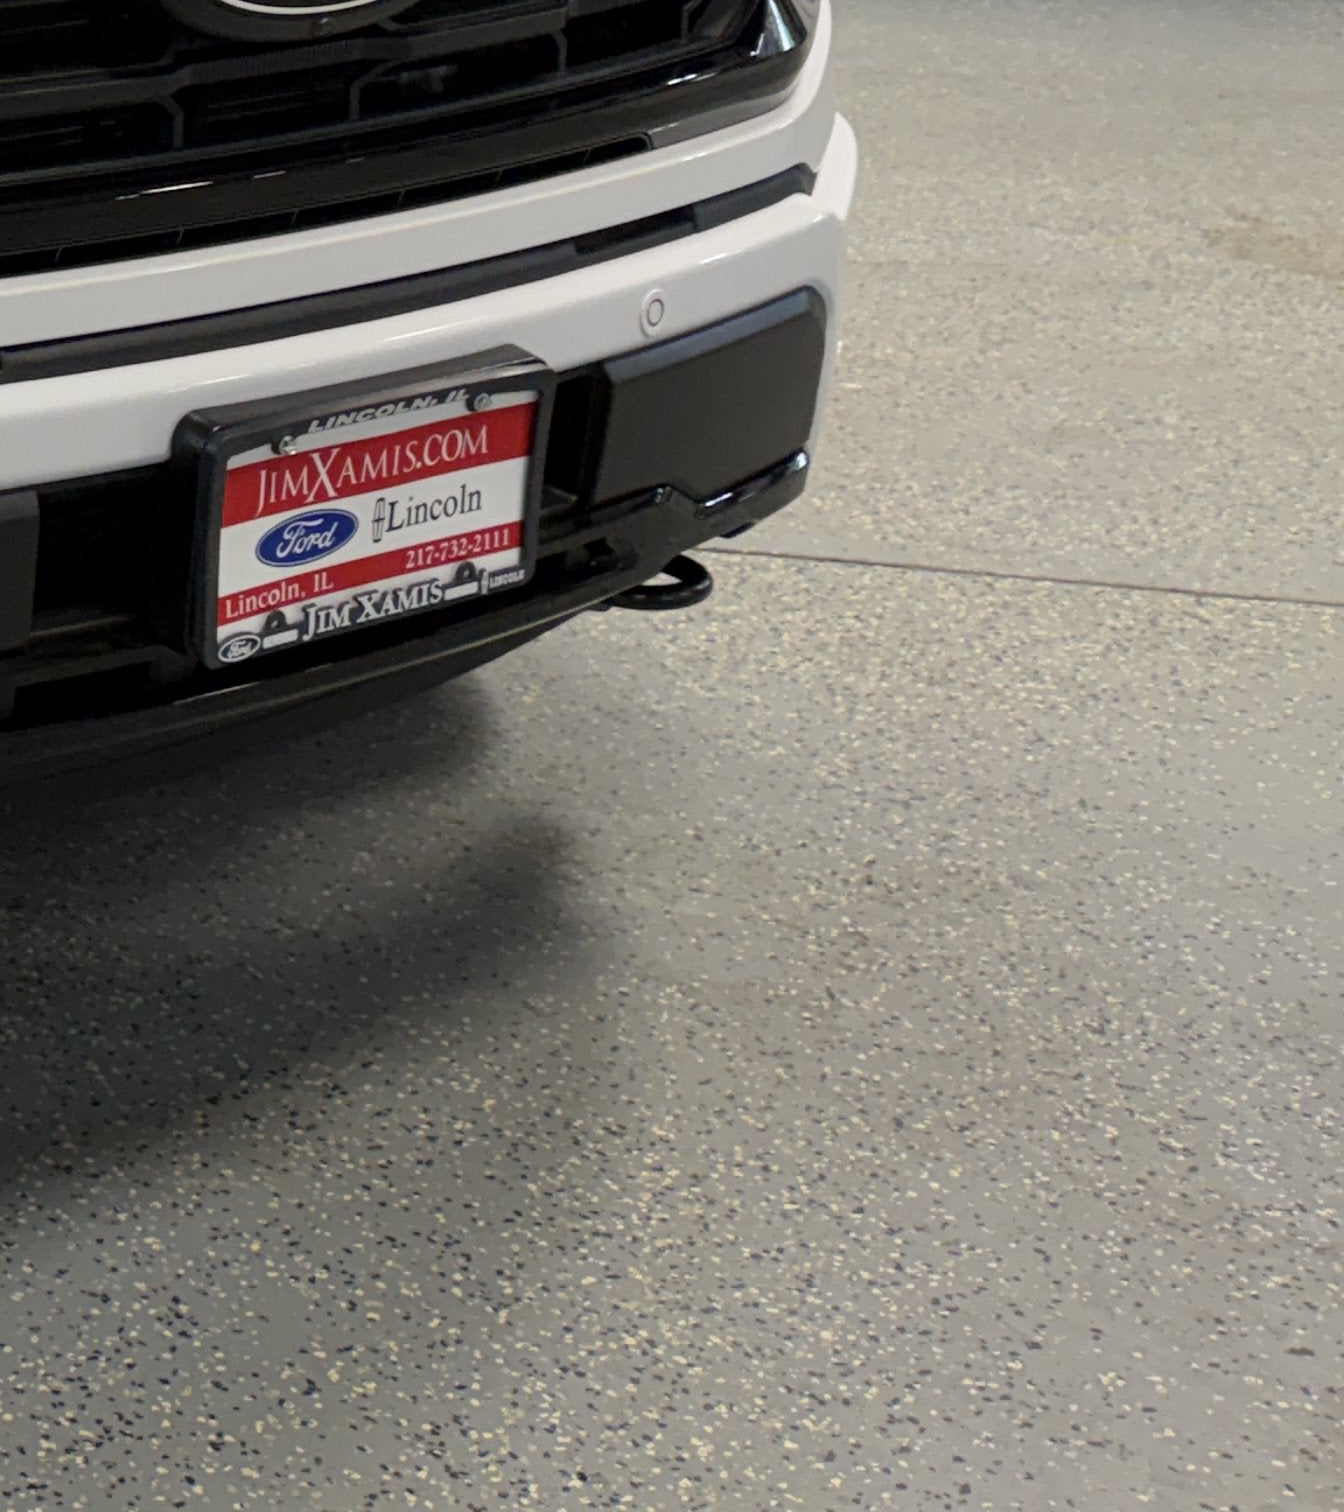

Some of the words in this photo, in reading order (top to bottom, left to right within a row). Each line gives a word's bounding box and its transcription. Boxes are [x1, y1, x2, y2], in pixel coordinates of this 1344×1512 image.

[255, 424, 489, 518] JIMXAMIS.COM
[276, 518, 339, 559] Ford
[385, 484, 483, 533] Lincoln
[405, 527, 510, 569] 217-732-2111
[225, 581, 306, 619] Lincoln,
[313, 571, 334, 593] IL
[302, 604, 352, 641] JIM
[356, 580, 443, 624] XAMIS
